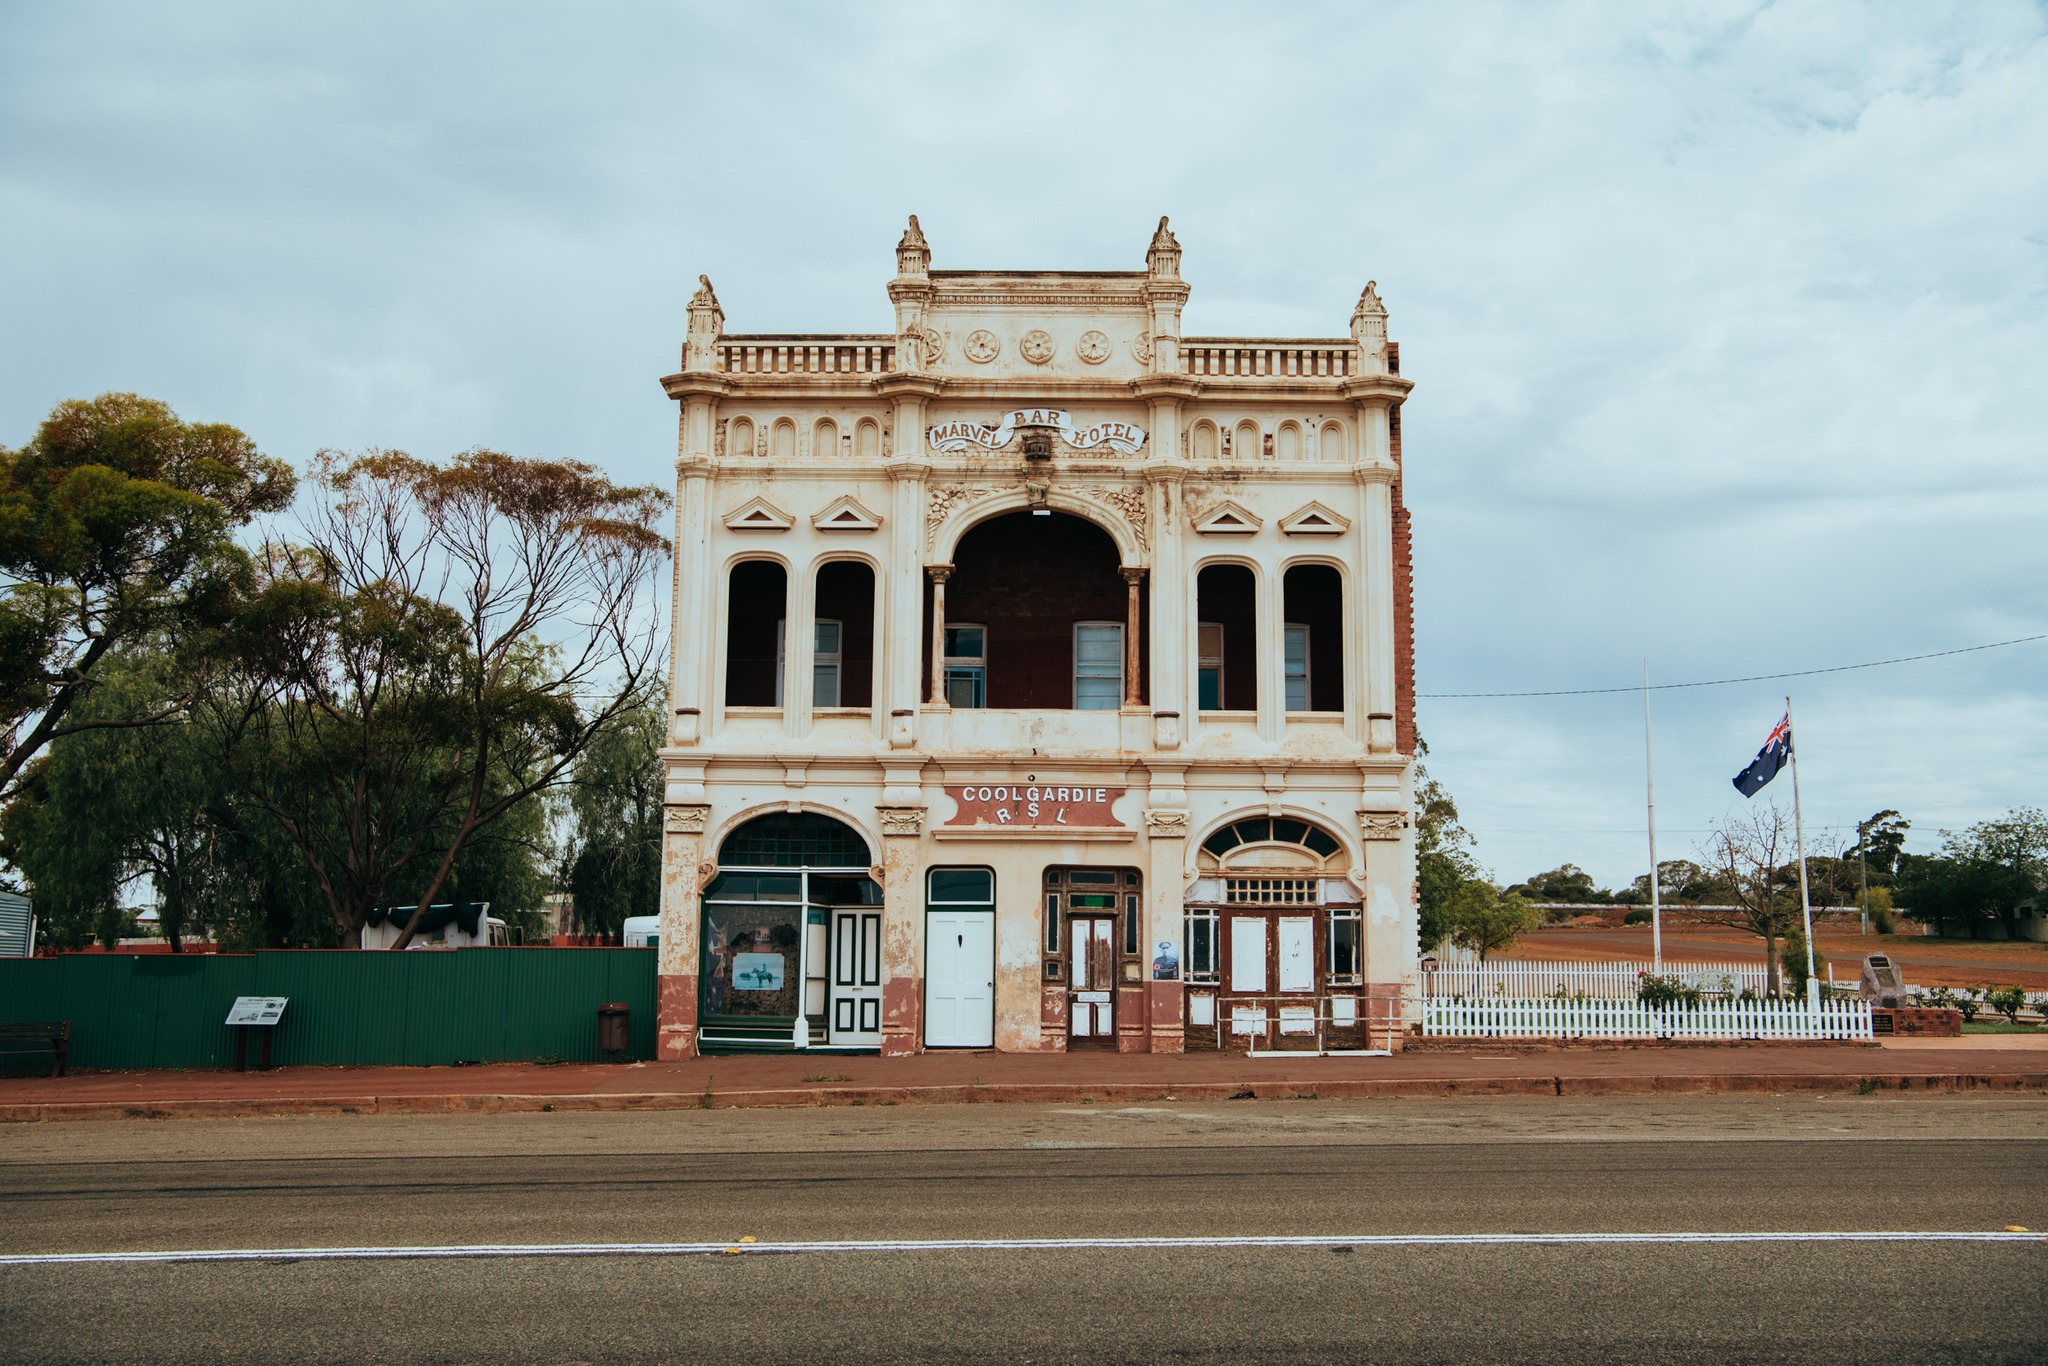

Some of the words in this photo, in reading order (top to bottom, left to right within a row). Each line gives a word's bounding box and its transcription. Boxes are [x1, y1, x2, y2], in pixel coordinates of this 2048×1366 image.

[934, 424, 1002, 447] MARVEL
[1014, 410, 1060, 426] BAR
[1073, 422, 1136, 447] HOTEL
[962, 786, 1107, 803] COOLGARDIE
